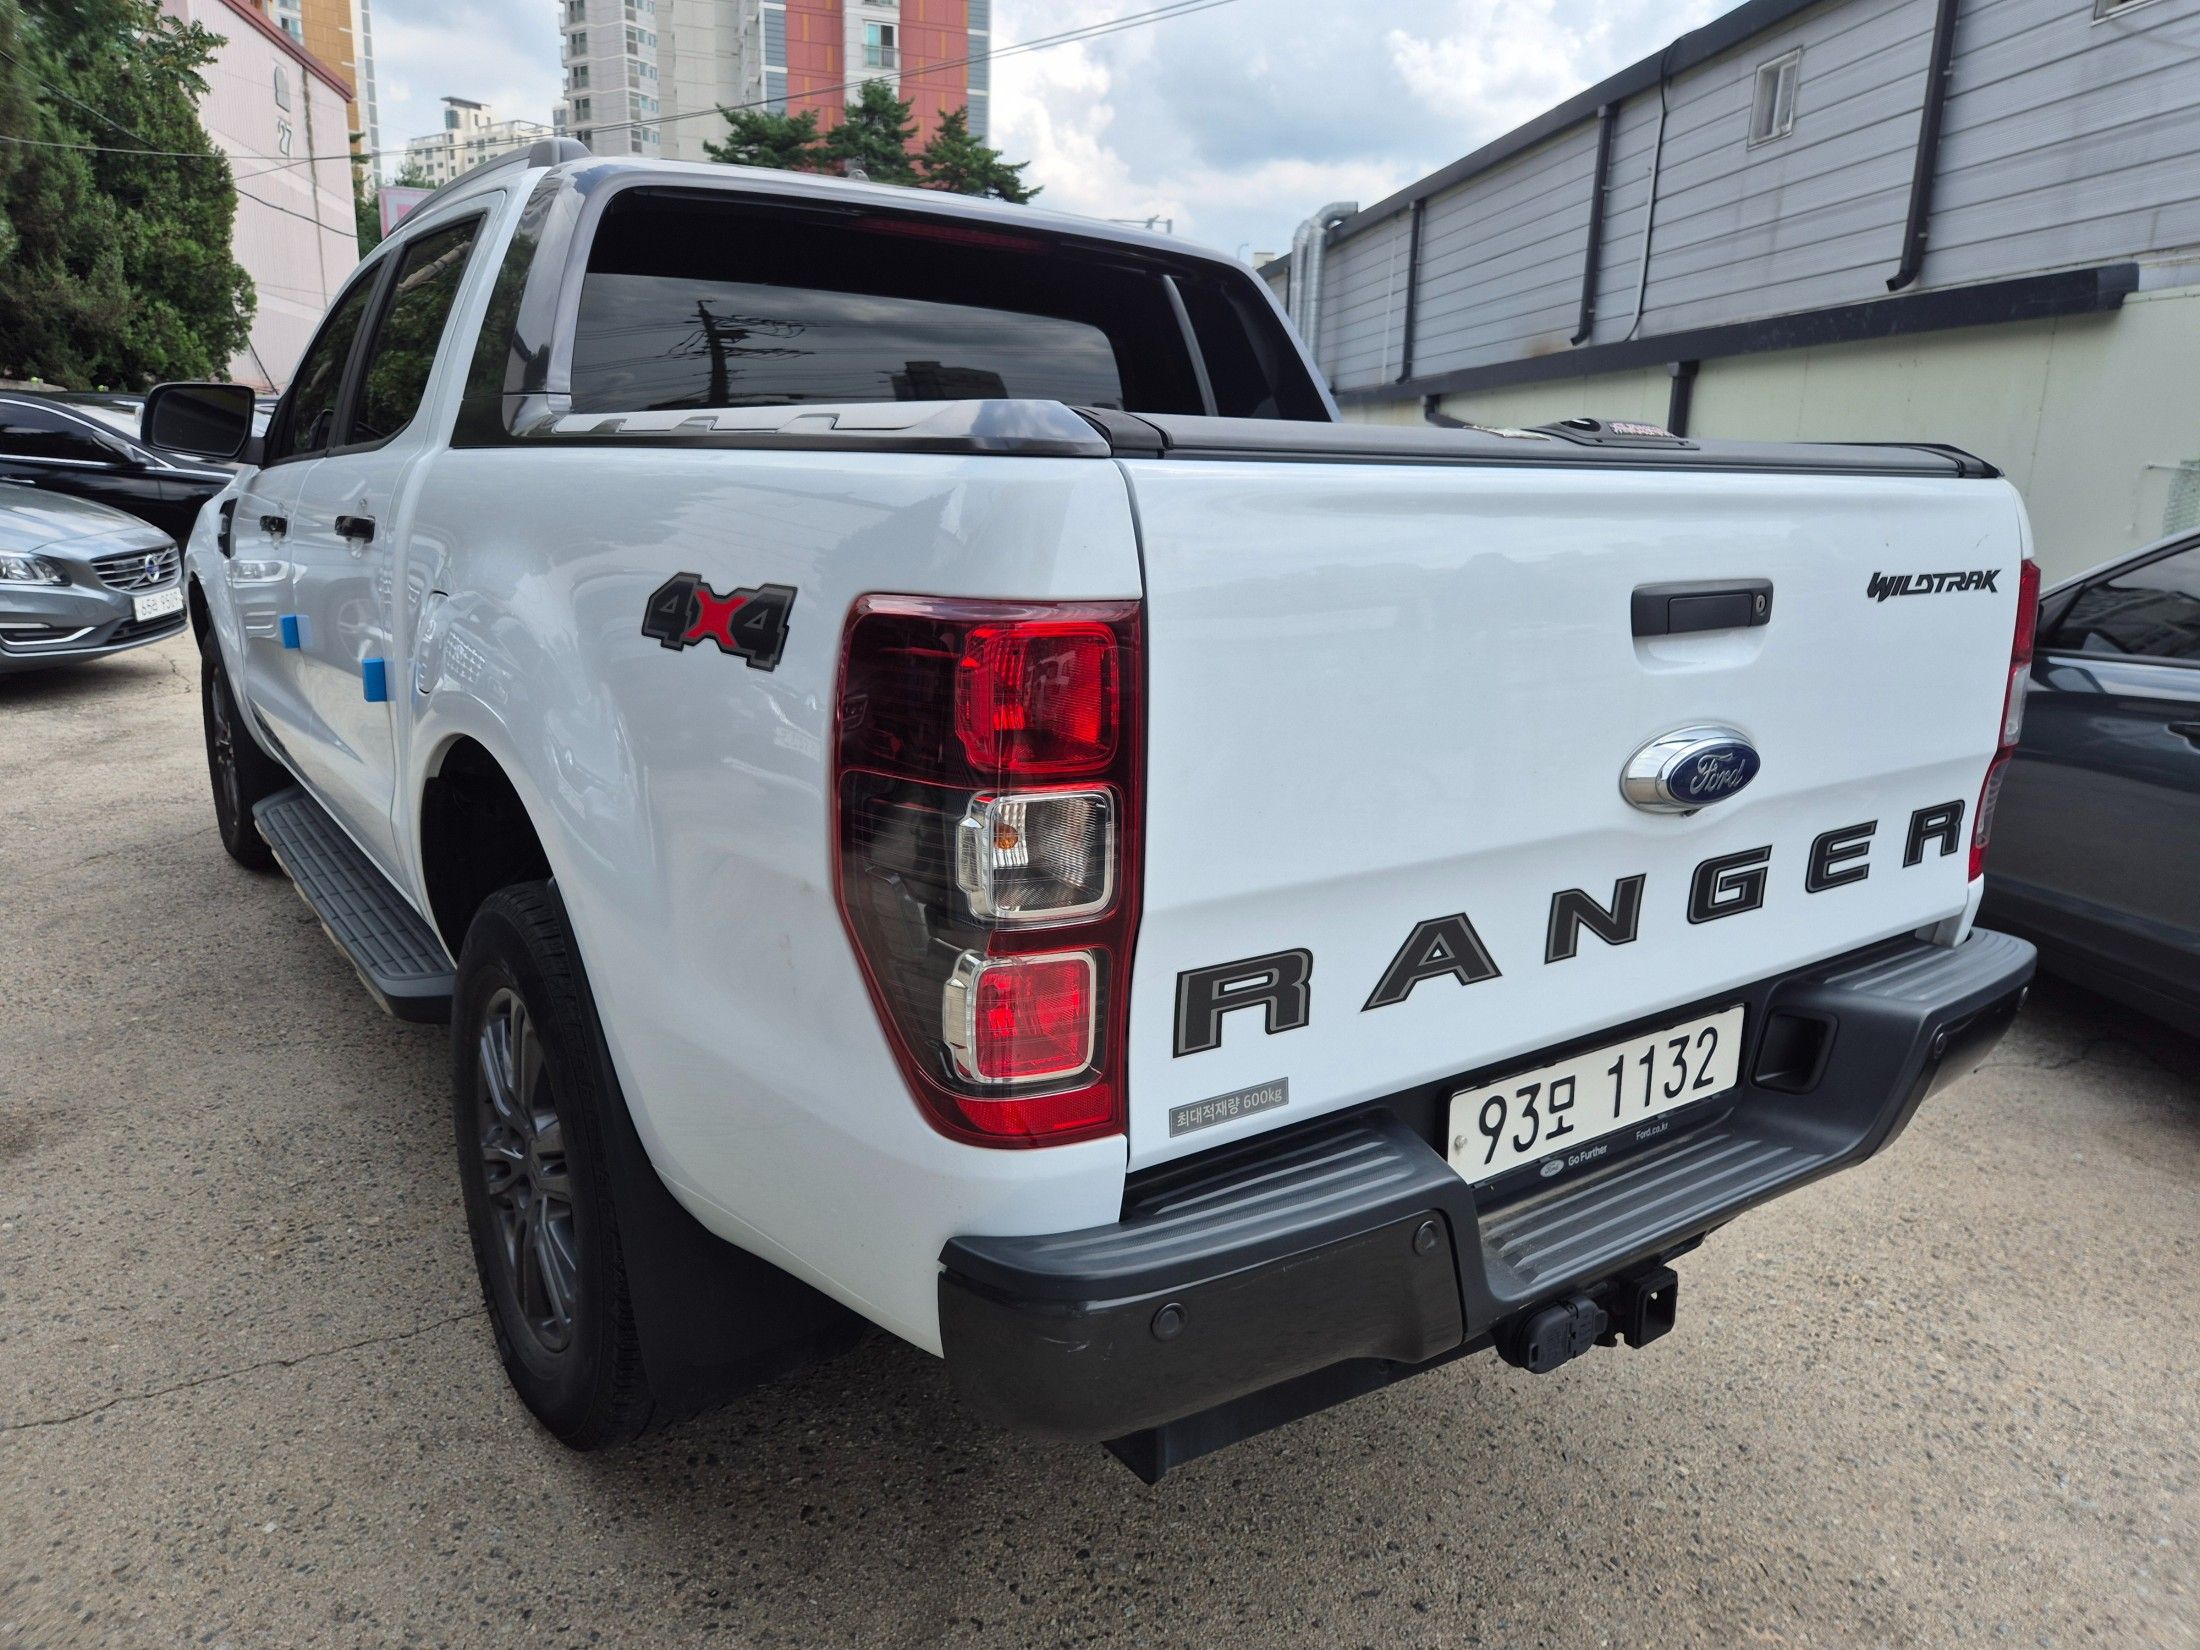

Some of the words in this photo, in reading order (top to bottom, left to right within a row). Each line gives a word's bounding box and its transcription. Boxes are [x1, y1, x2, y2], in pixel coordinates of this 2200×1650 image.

[1866, 568, 2002, 602] WILDTRAK
[1689, 752, 1746, 796] Ford
[1173, 799, 1966, 1058] RANGER
[1177, 1096, 1241, 1127] 최대적재량
[1243, 1088, 1282, 1109] 600kg
[1477, 1075, 1577, 1166] 93모
[1607, 1026, 1719, 1119] 1132
[1636, 1122, 1669, 1141] Ford.co.kr
[1568, 1154, 1580, 1166] Go
[1580, 1144, 1608, 1163] Further
